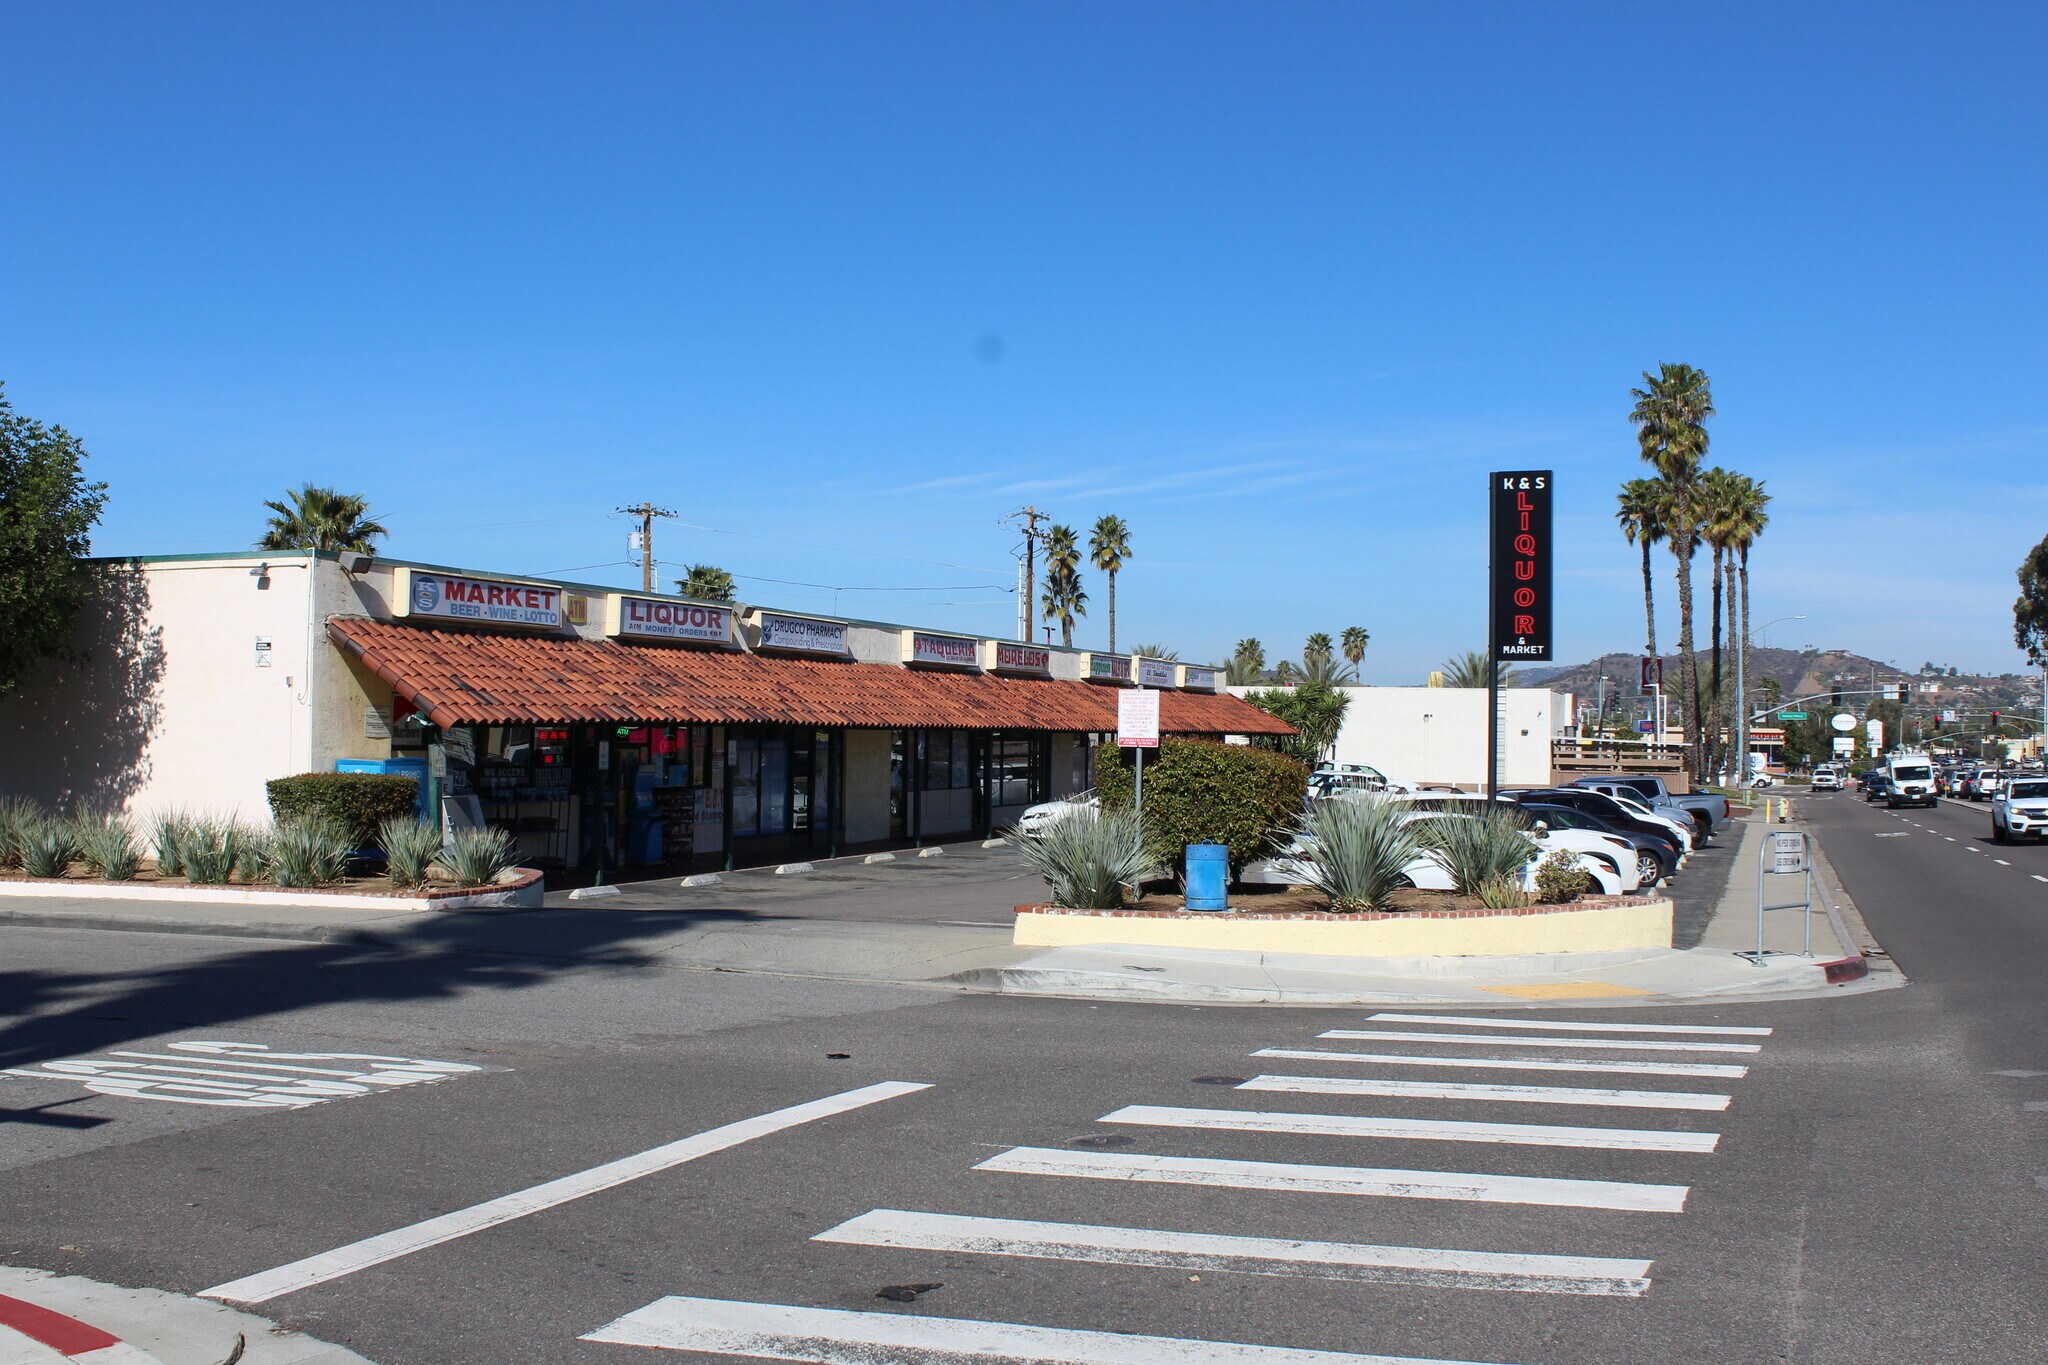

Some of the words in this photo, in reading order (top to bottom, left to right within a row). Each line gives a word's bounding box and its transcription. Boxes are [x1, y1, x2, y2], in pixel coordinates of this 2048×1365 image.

[1504, 477, 1514, 490] K
[1519, 477, 1530, 490] &
[1535, 477, 1545, 489] S
[1514, 491, 1536, 634] LIQUOR
[416, 581, 435, 593] K
[445, 581, 555, 610] MARKET
[419, 598, 434, 608] S
[568, 600, 586, 619] ATM
[450, 603, 481, 617] BEER
[488, 606, 517, 620] WINE
[525, 610, 557, 624] LOTTO
[630, 601, 722, 629] LIQUOR
[645, 624, 673, 634] MONEY
[679, 628, 708, 637] ORDERS
[774, 619, 805, 635] DRUGCO
[806, 624, 844, 640] PHARMACY
[774, 635, 810, 649] Compounding
[810, 640, 815, 648] &
[815, 640, 844, 650] Prescription
[922, 638, 976, 658] TAQUERIA
[1503, 645, 1544, 654] MARKET
[1518, 637, 1526, 645] &
[997, 647, 1041, 667] MORELOS
[0, 1040, 482, 1109] STOP
